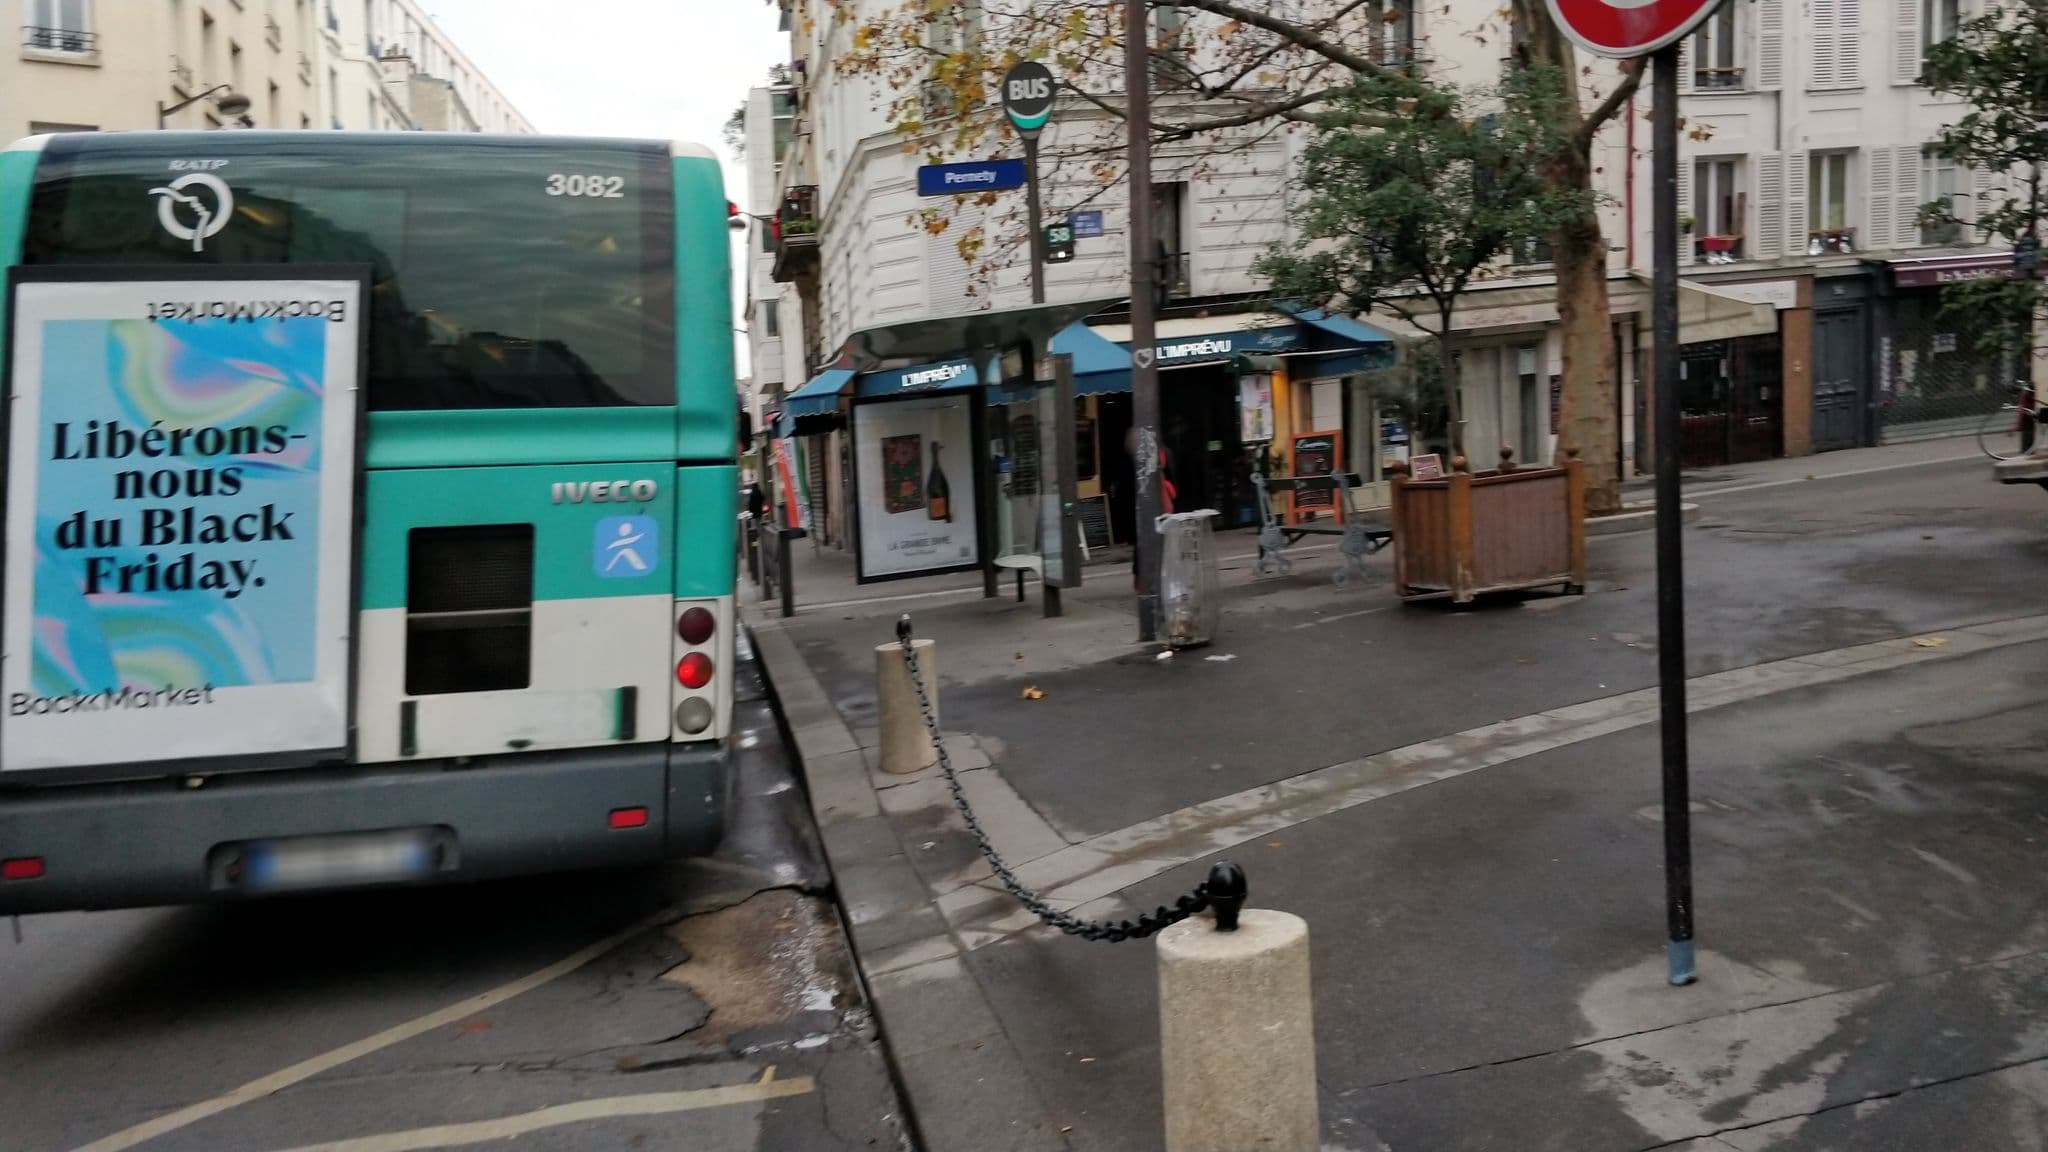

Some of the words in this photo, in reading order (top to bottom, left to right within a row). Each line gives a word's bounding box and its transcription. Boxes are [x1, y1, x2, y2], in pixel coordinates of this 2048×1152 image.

[1008, 77, 1050, 100] BUS
[168, 159, 229, 171] RATP
[545, 173, 625, 199] 3082
[1156, 339, 1232, 359] L'IMPRÉVU
[50, 420, 307, 461] Libérons-
[113, 465, 244, 501] nous
[551, 479, 658, 504] IVECO
[55, 510, 121, 550] du
[139, 503, 296, 546] Black
[83, 552, 267, 600] Friday.
